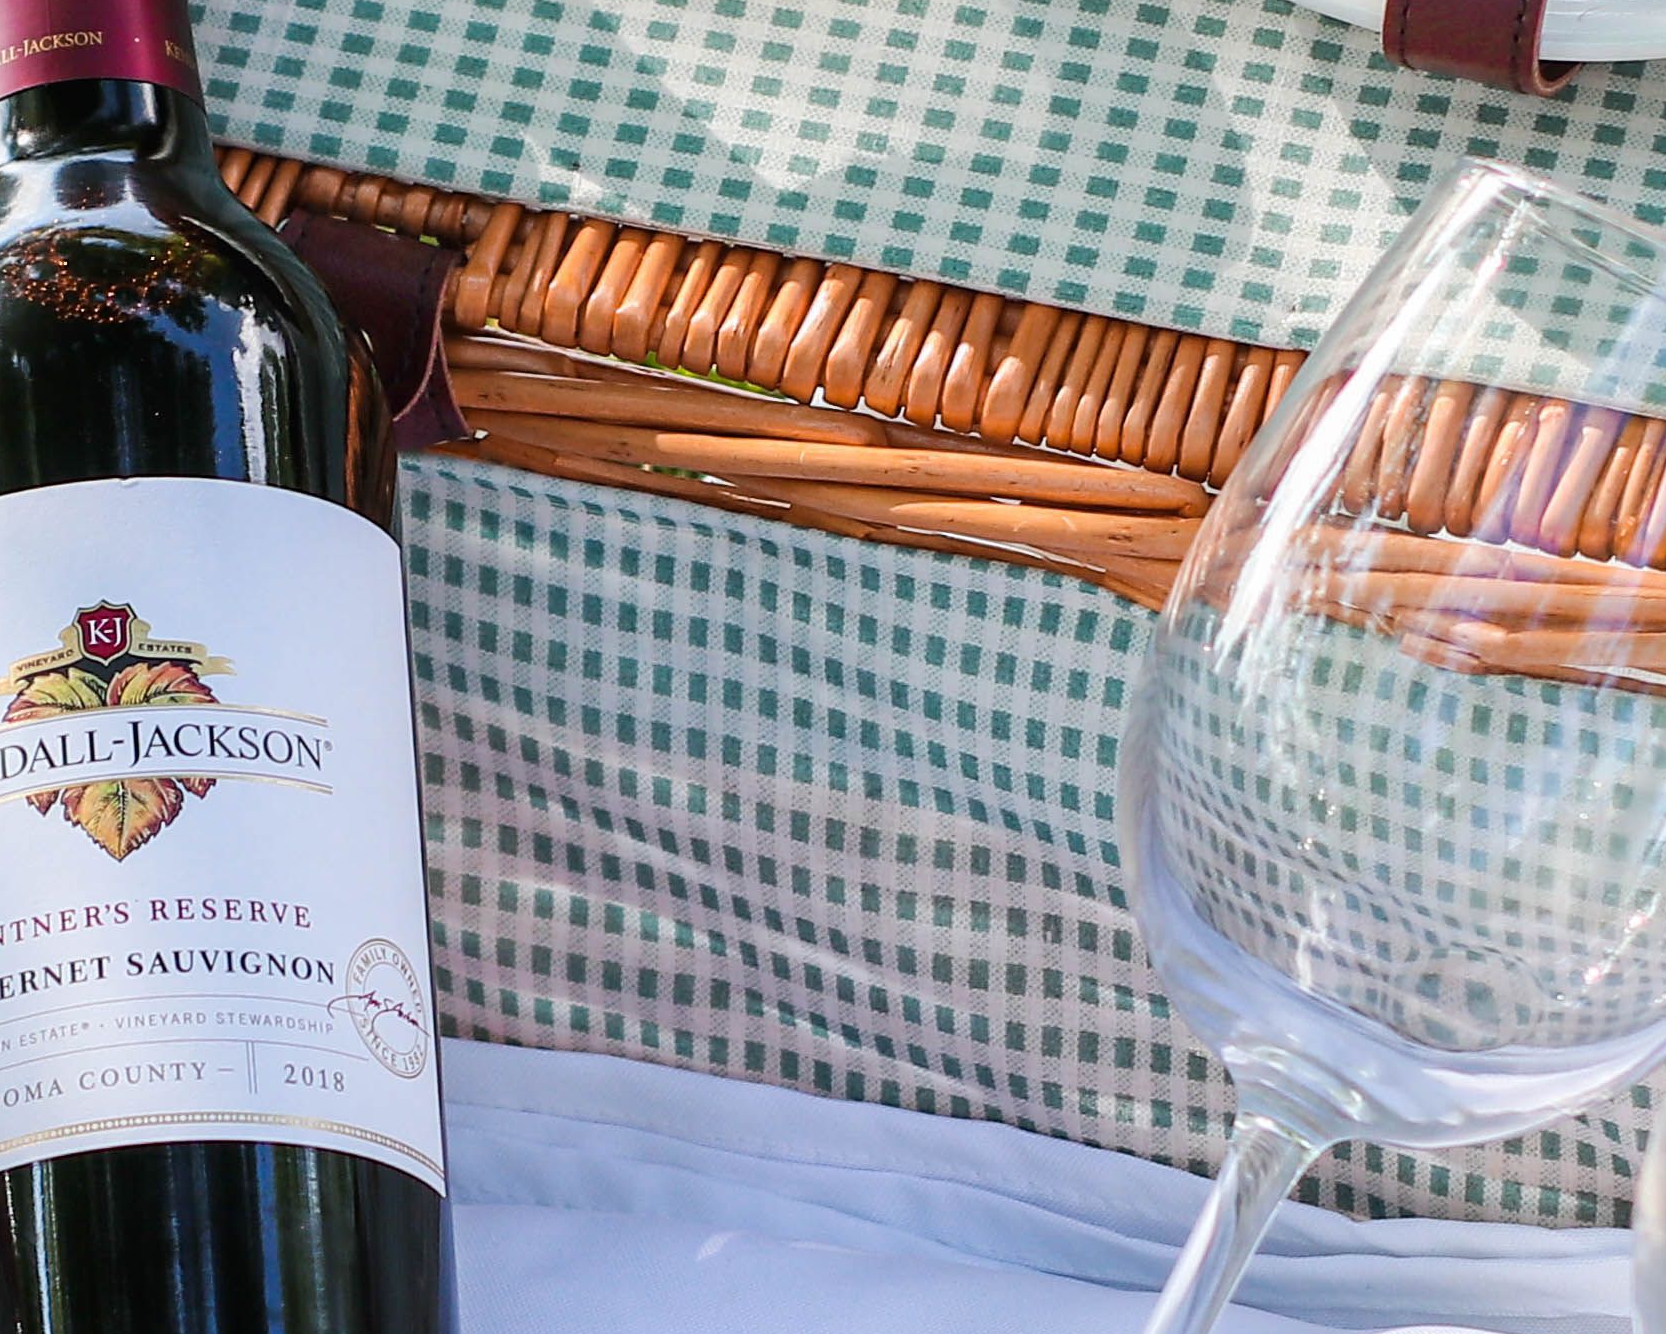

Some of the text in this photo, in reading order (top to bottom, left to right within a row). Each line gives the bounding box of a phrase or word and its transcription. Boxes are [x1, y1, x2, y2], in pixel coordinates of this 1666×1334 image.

[87, 616, 123, 649] K-J
[16, 641, 192, 673] VINEYARD ESTATES
[150, 898, 313, 929] RESERVE
[126, 949, 336, 986] SAUVIGNON
[353, 946, 387, 985] FAMILY
[115, 1011, 207, 1030] VINEYARD
[215, 1011, 335, 1036] STEWARDSHIP
[282, 1063, 346, 1094] 2018
